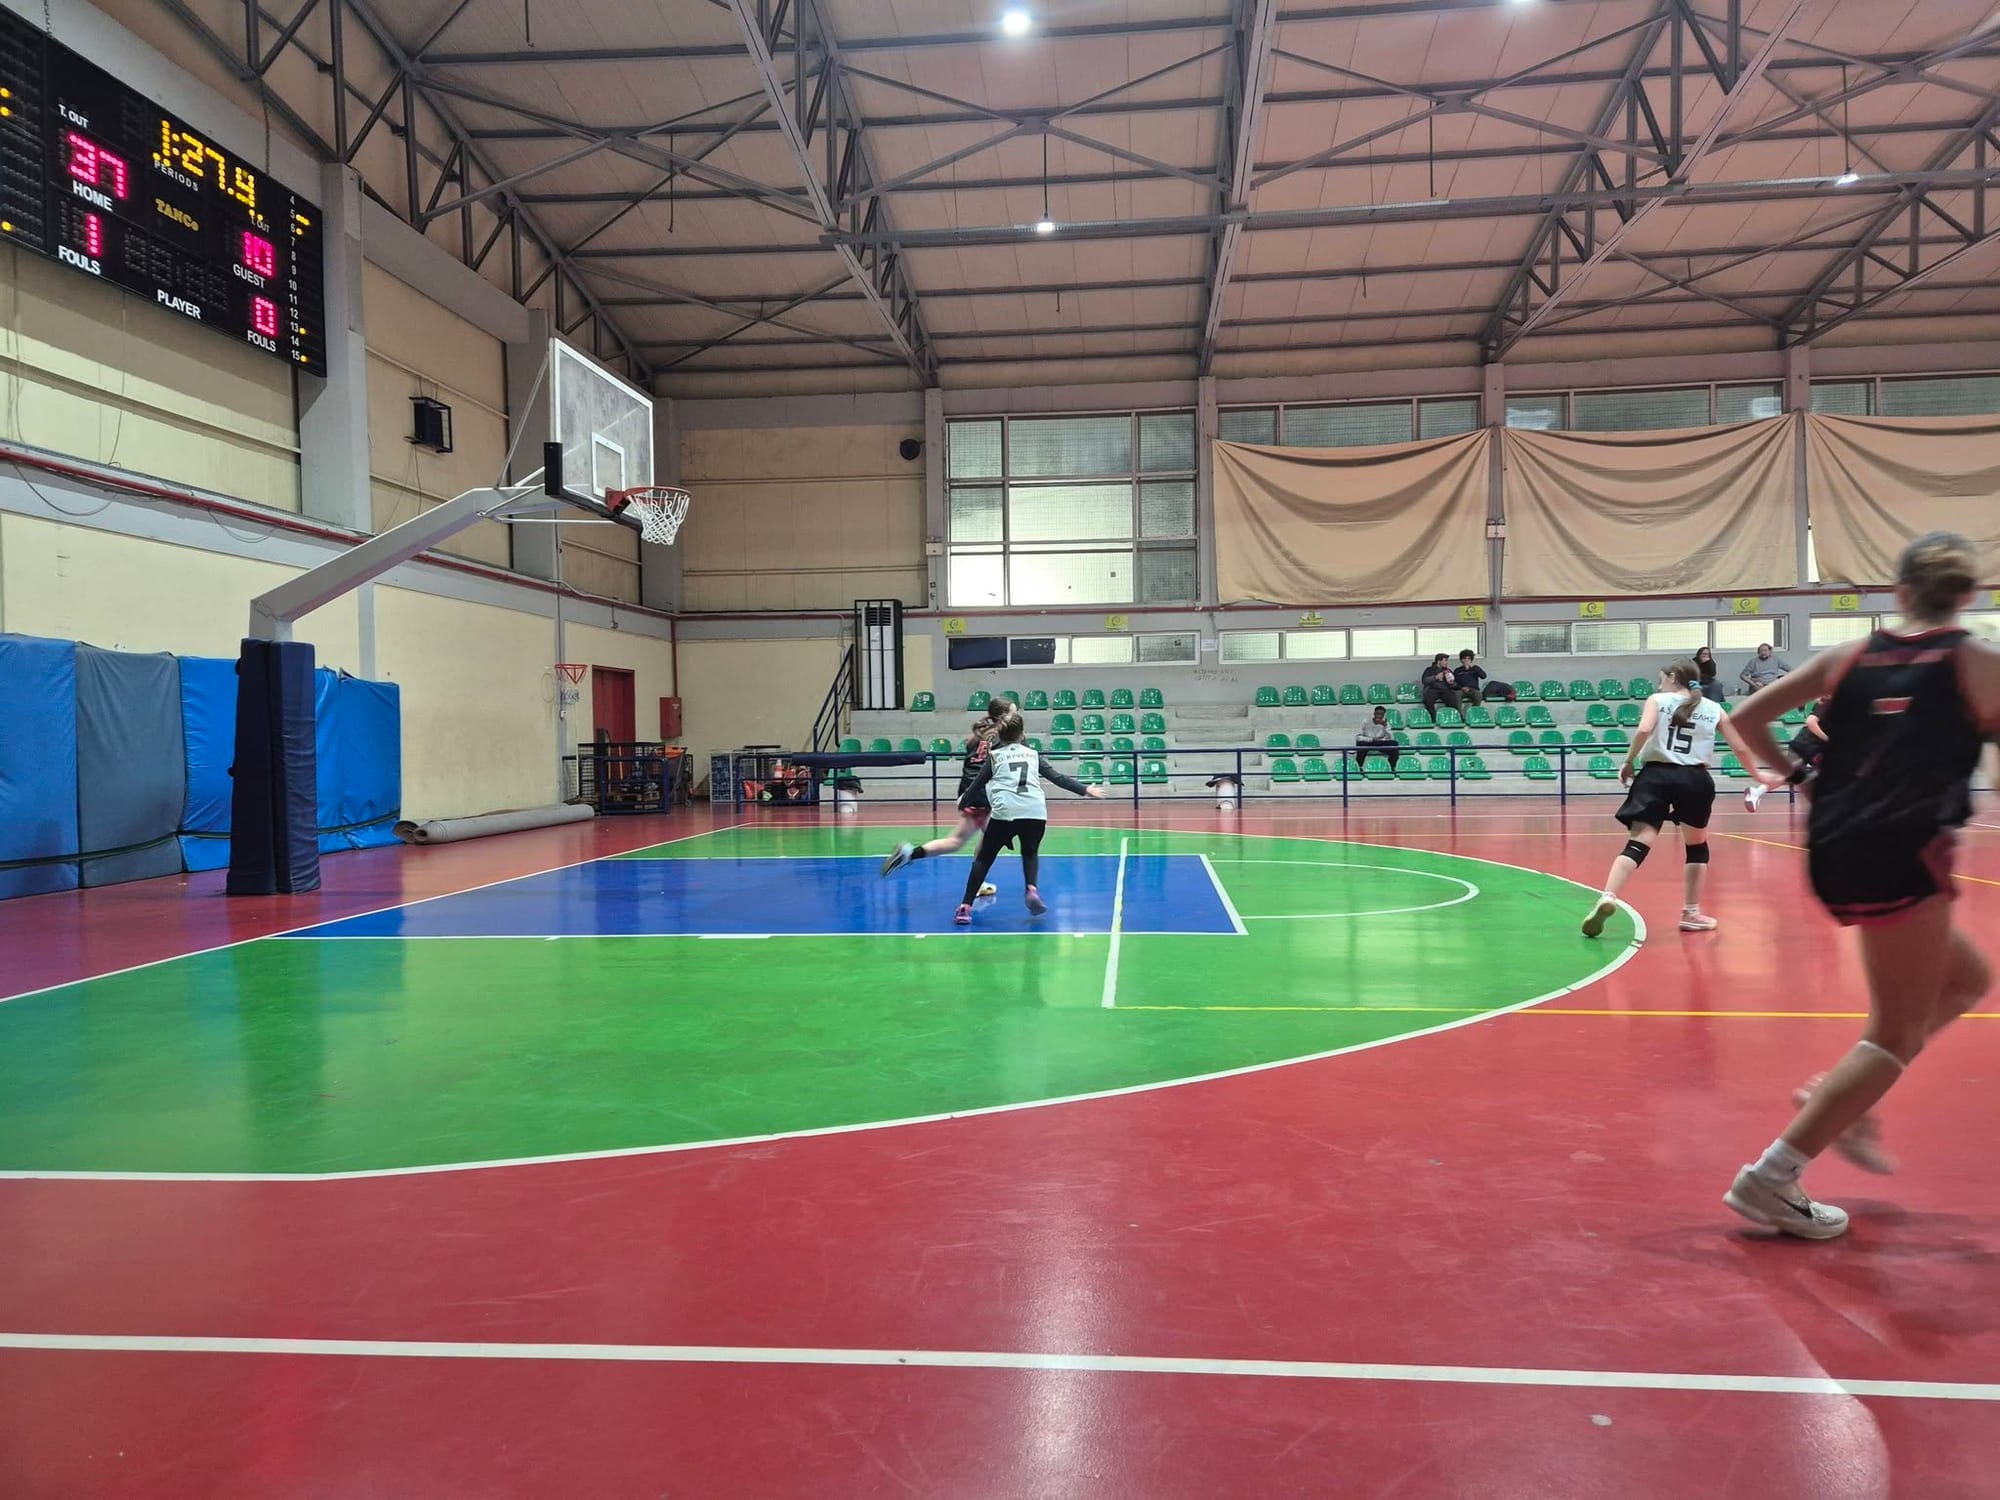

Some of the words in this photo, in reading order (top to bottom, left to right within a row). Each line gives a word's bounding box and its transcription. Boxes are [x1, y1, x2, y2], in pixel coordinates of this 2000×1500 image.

[69, 110, 89, 128] OUT
[68, 133, 126, 200] 37
[153, 159, 199, 192] PERIODS
[72, 180, 113, 212] HOME
[289, 195, 296, 206] 4
[289, 209, 296, 219] 5
[289, 222, 296, 233] 6
[290, 237, 296, 247] 7
[58, 245, 101, 275] FOULS
[243, 231, 273, 277] 10
[290, 251, 297, 261] 8
[233, 264, 266, 289] GUEST
[290, 265, 297, 275] 9
[288, 279, 298, 291] 10
[157, 289, 201, 319] PLAYER
[289, 293, 298, 305] 11
[289, 307, 299, 320] 12
[290, 321, 299, 333] 13
[247, 330, 277, 352] FOULS
[290, 335, 300, 347] 14
[291, 349, 300, 361] 15
[1667, 722, 1695, 754] 15
[1009, 761, 1029, 793] 7
